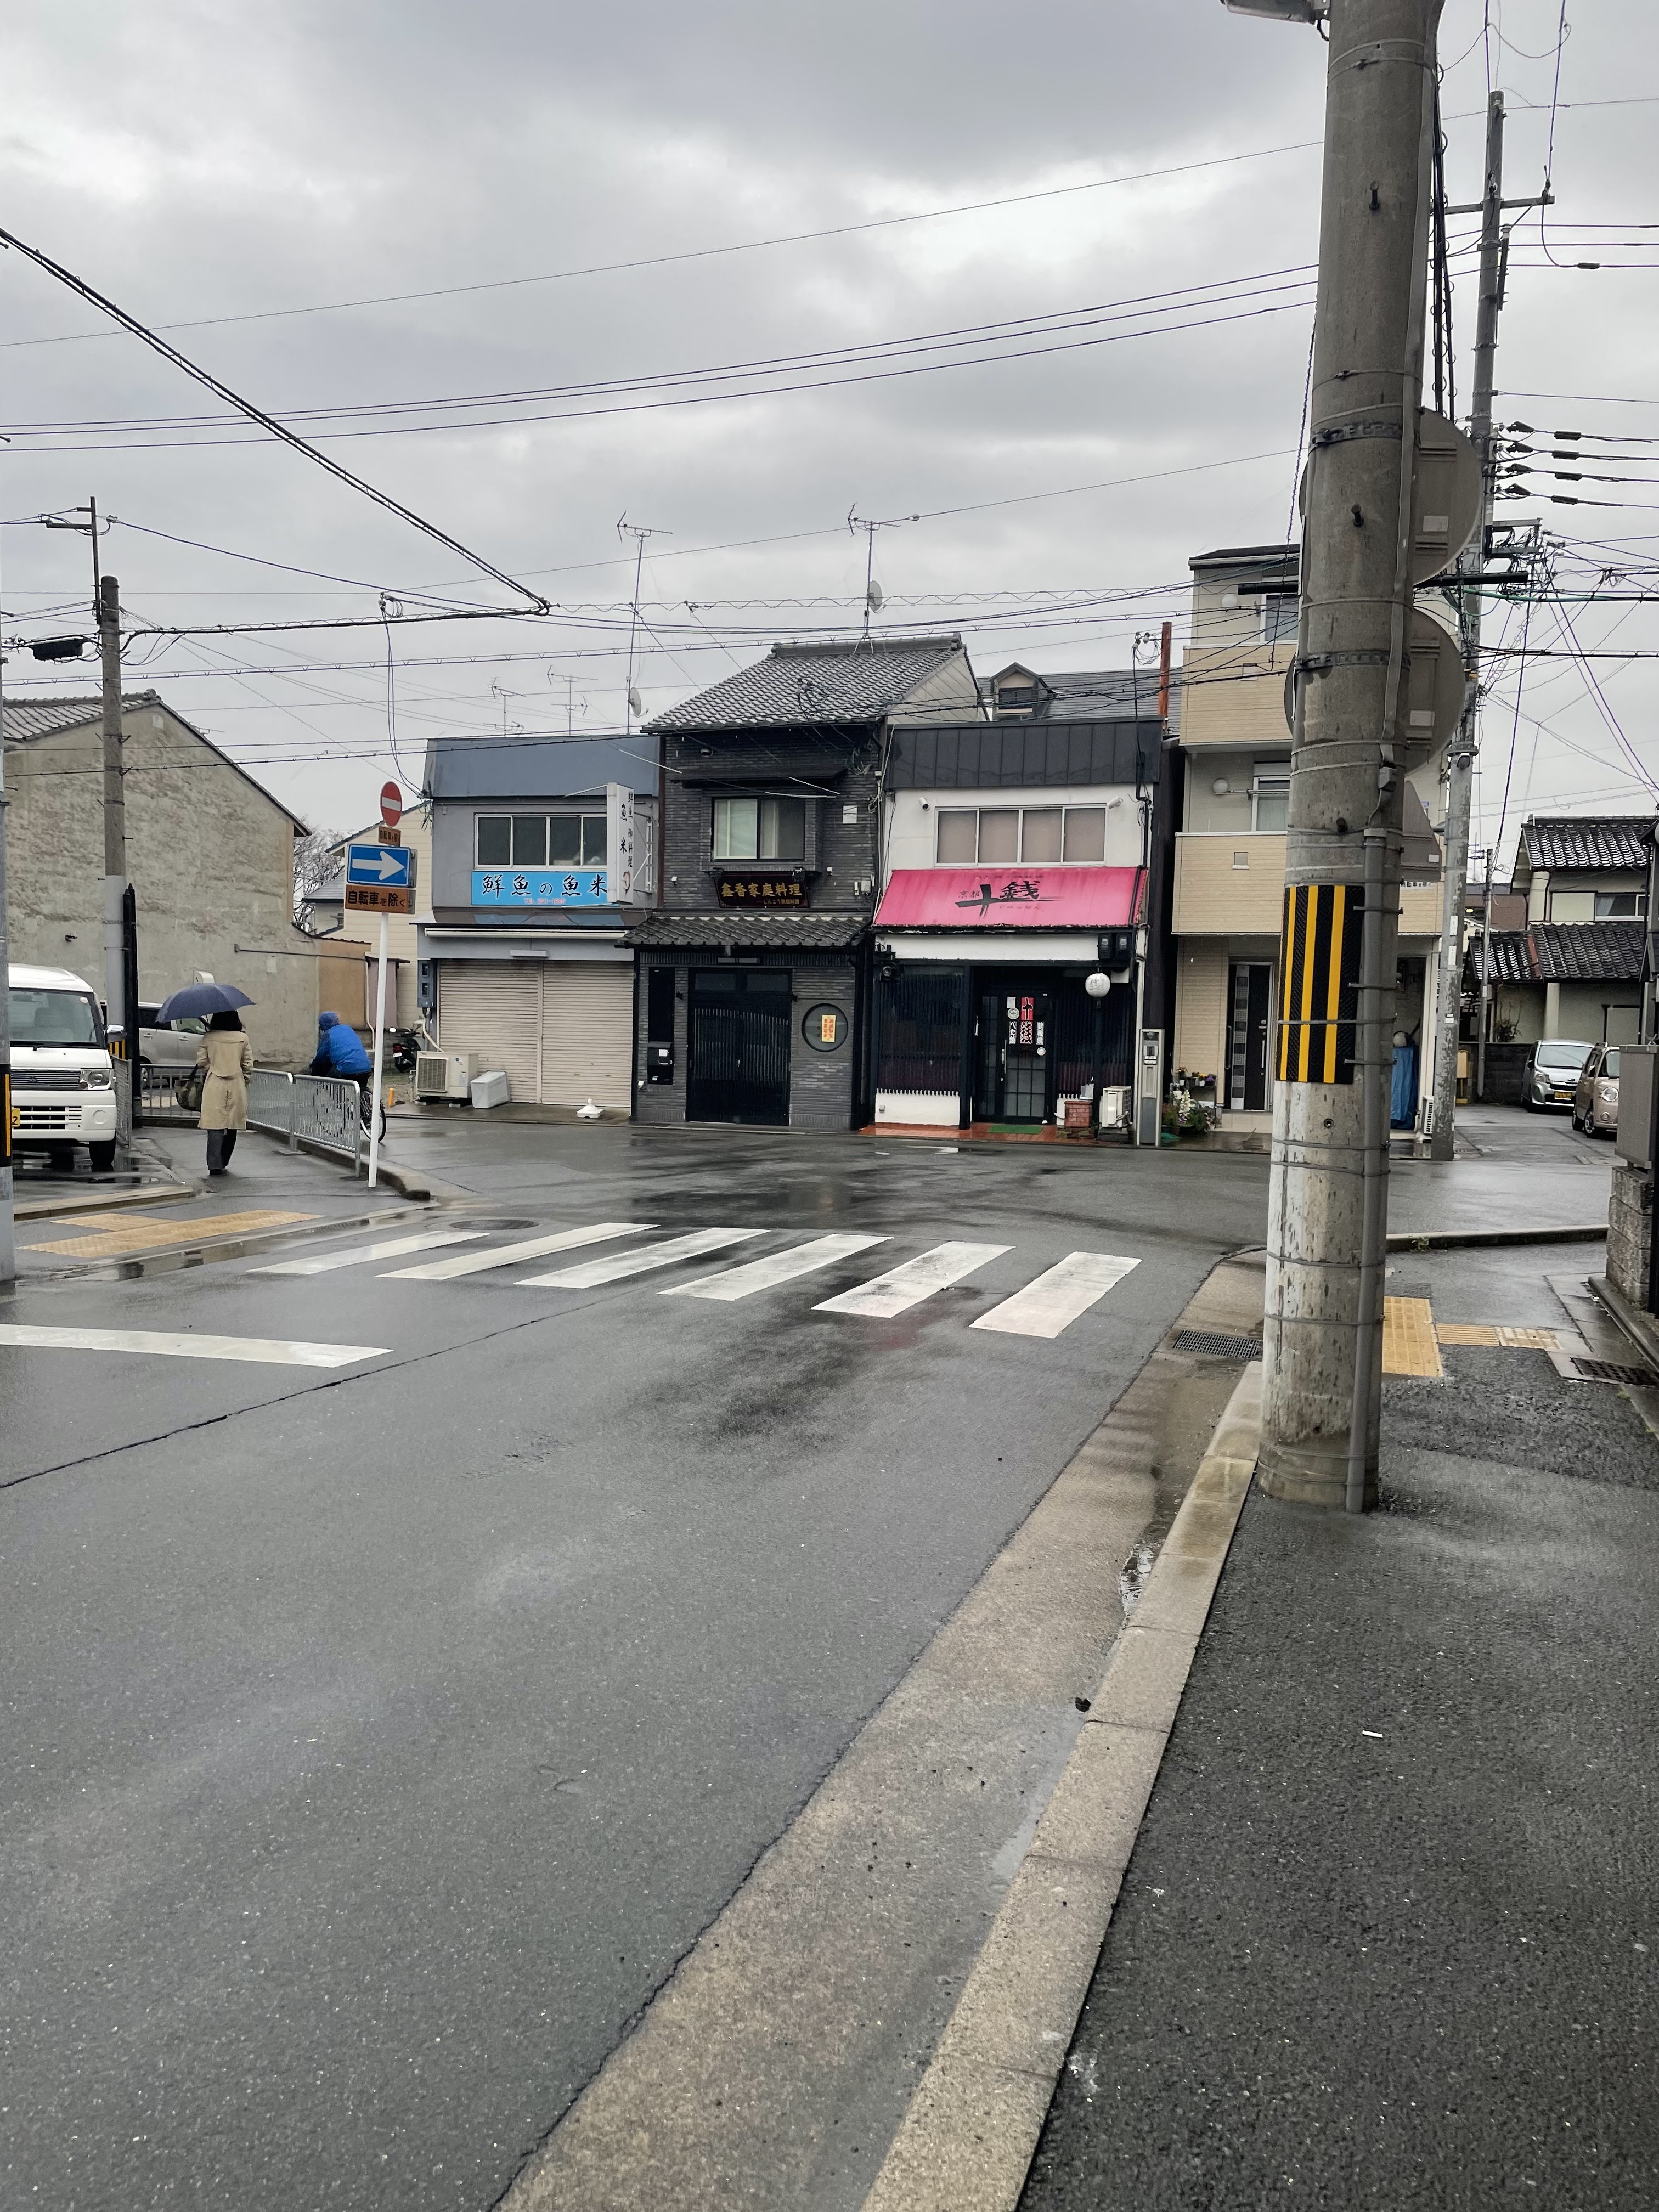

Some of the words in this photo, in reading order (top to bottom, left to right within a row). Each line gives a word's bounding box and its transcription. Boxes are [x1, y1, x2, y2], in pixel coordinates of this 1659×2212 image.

[620, 803, 628, 854] 魚米
[482, 874, 607, 898] 鮮魚の魚米
[721, 882, 802, 898] 鑫香家庭料理
[958, 890, 981, 899] 京都
[348, 890, 405, 908] 自転車を除く
[955, 881, 1063, 919] 十銭
